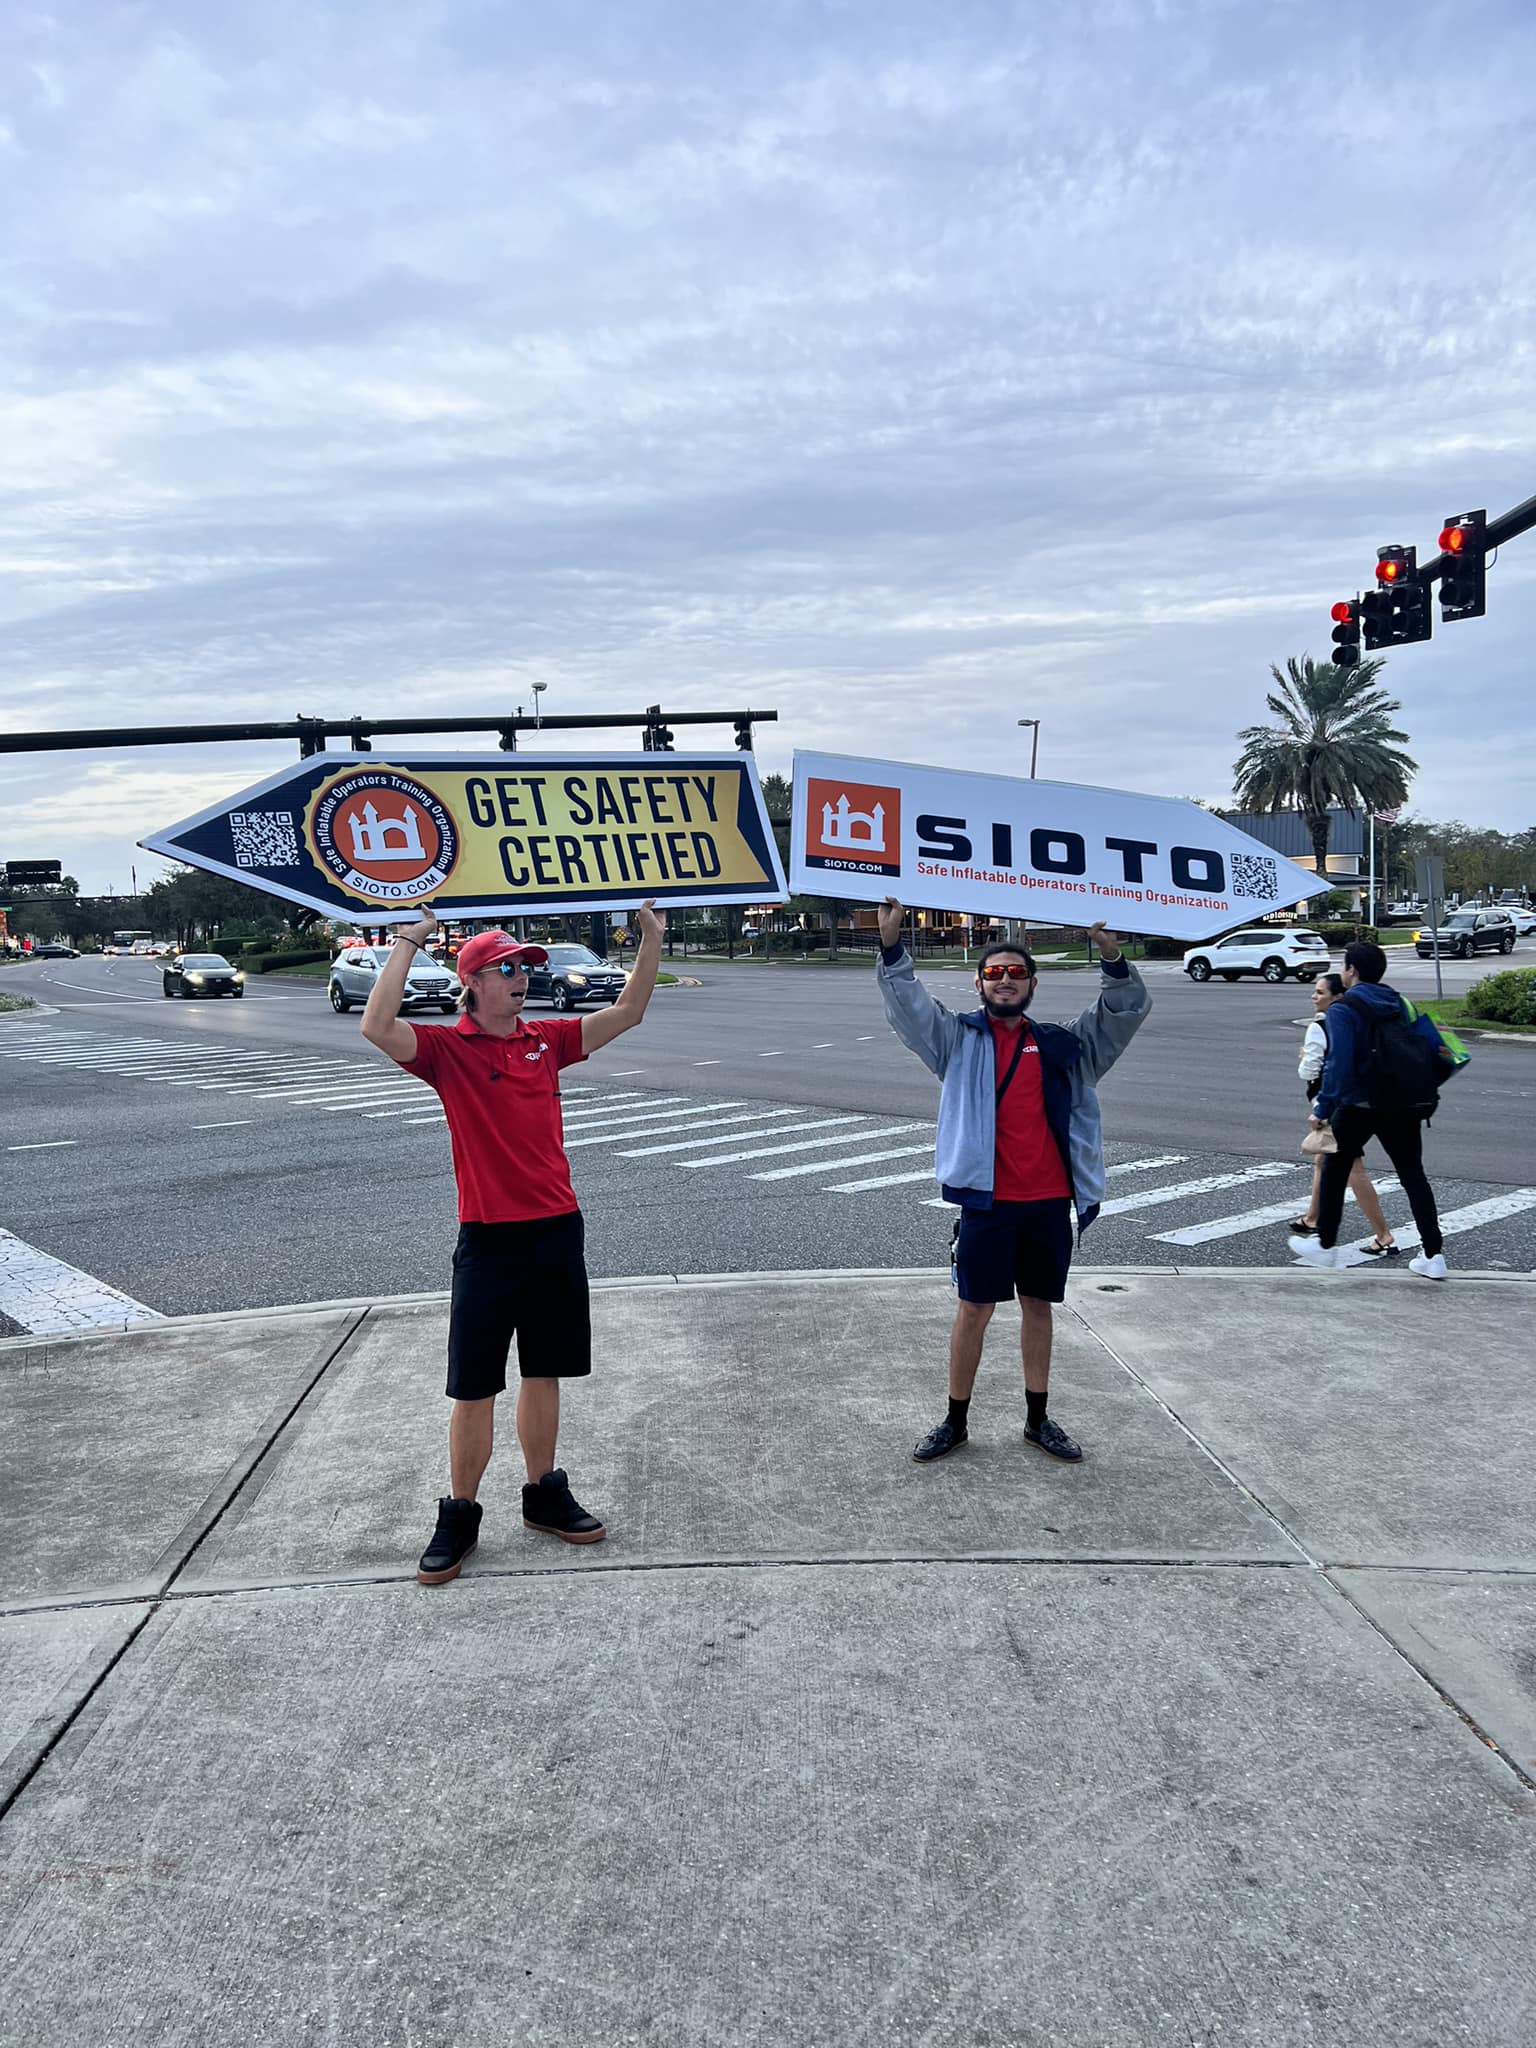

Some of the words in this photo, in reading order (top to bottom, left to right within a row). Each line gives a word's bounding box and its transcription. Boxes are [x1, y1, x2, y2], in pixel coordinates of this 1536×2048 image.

[332, 776, 387, 798] Operators
[391, 776, 433, 807] Training
[465, 777, 547, 827] GET
[563, 776, 718, 825] SAFETY
[317, 798, 337, 847] Inflatable
[431, 805, 454, 870] Organization
[326, 848, 347, 873] Safe
[498, 831, 721, 887] CERTIFIED
[824, 859, 883, 873] SIOTO.COM
[916, 814, 1226, 893] SIOTO
[352, 873, 439, 896] SIOTO.COM
[917, 862, 948, 877] Safe
[951, 866, 1016, 885] Inflatable
[1020, 874, 1086, 893] Operators
[1089, 882, 1142, 902] Training
[1146, 889, 1229, 911] Organization
